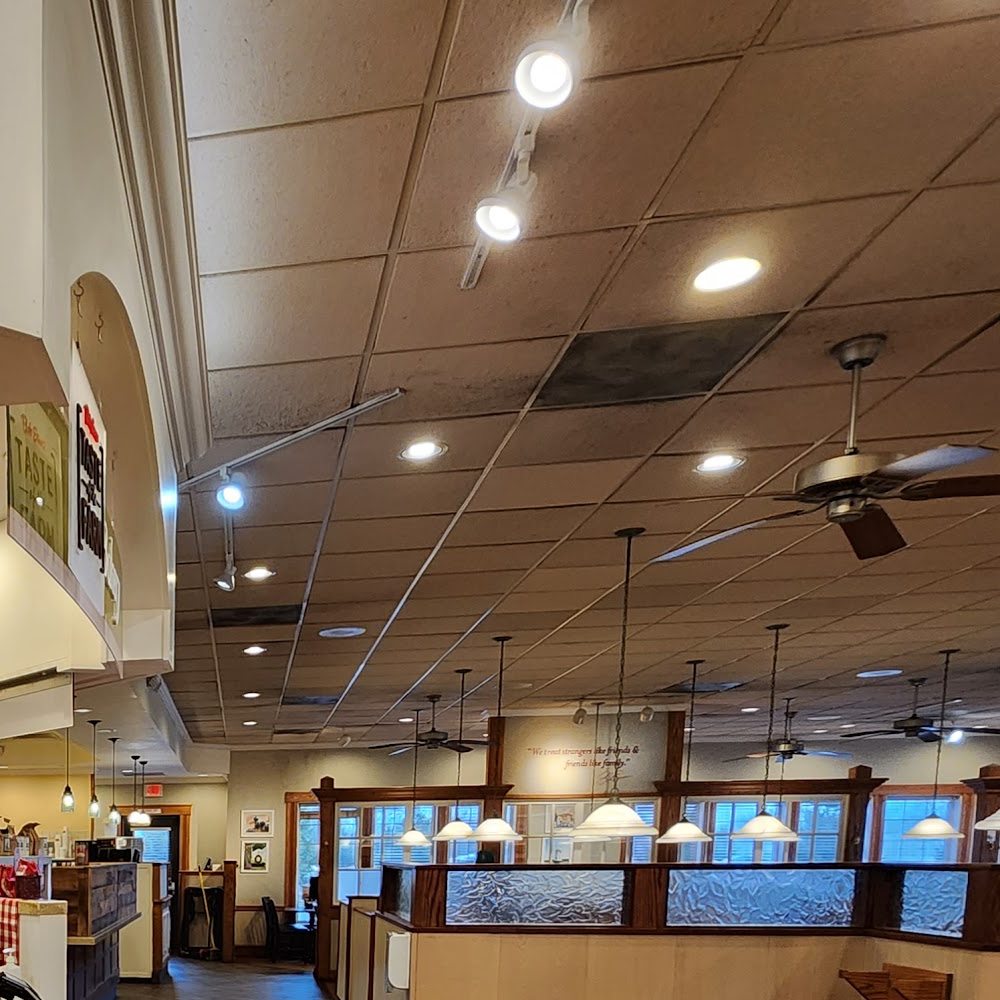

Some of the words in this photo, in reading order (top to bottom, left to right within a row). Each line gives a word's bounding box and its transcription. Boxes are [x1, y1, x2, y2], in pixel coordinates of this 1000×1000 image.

[14, 436, 53, 497] TASTE
[562, 747, 592, 757] strangers
[606, 746, 631, 756] friends
[632, 745, 640, 754] &
[564, 759, 588, 770] friends
